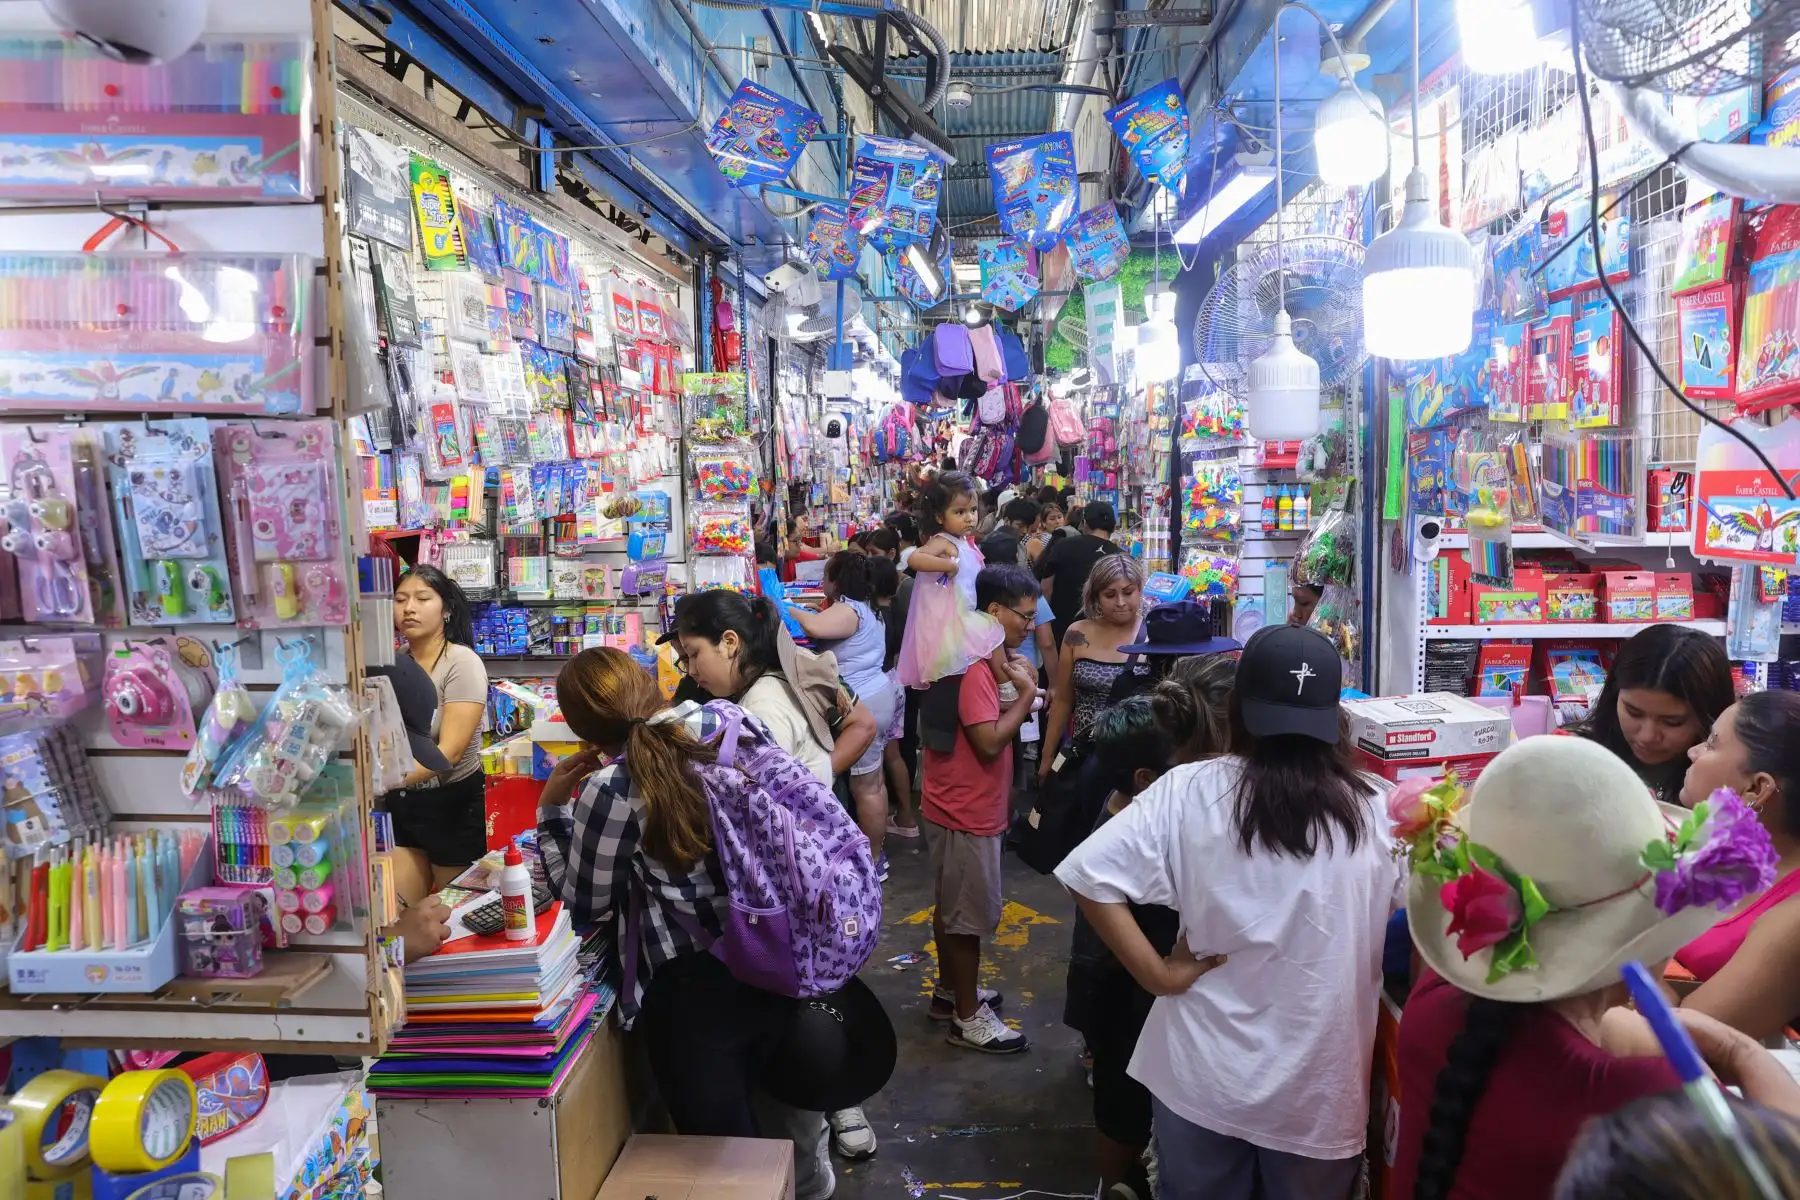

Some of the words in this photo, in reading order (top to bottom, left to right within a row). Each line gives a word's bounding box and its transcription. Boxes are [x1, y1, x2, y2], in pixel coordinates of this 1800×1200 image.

[744, 85, 779, 103] ARTESCO
[994, 144, 1022, 154] ARTESCO
[432, 208, 449, 224] Tips
[1735, 485, 1778, 496] FABER-CASTELL
[1397, 731, 1432, 744] Standford
